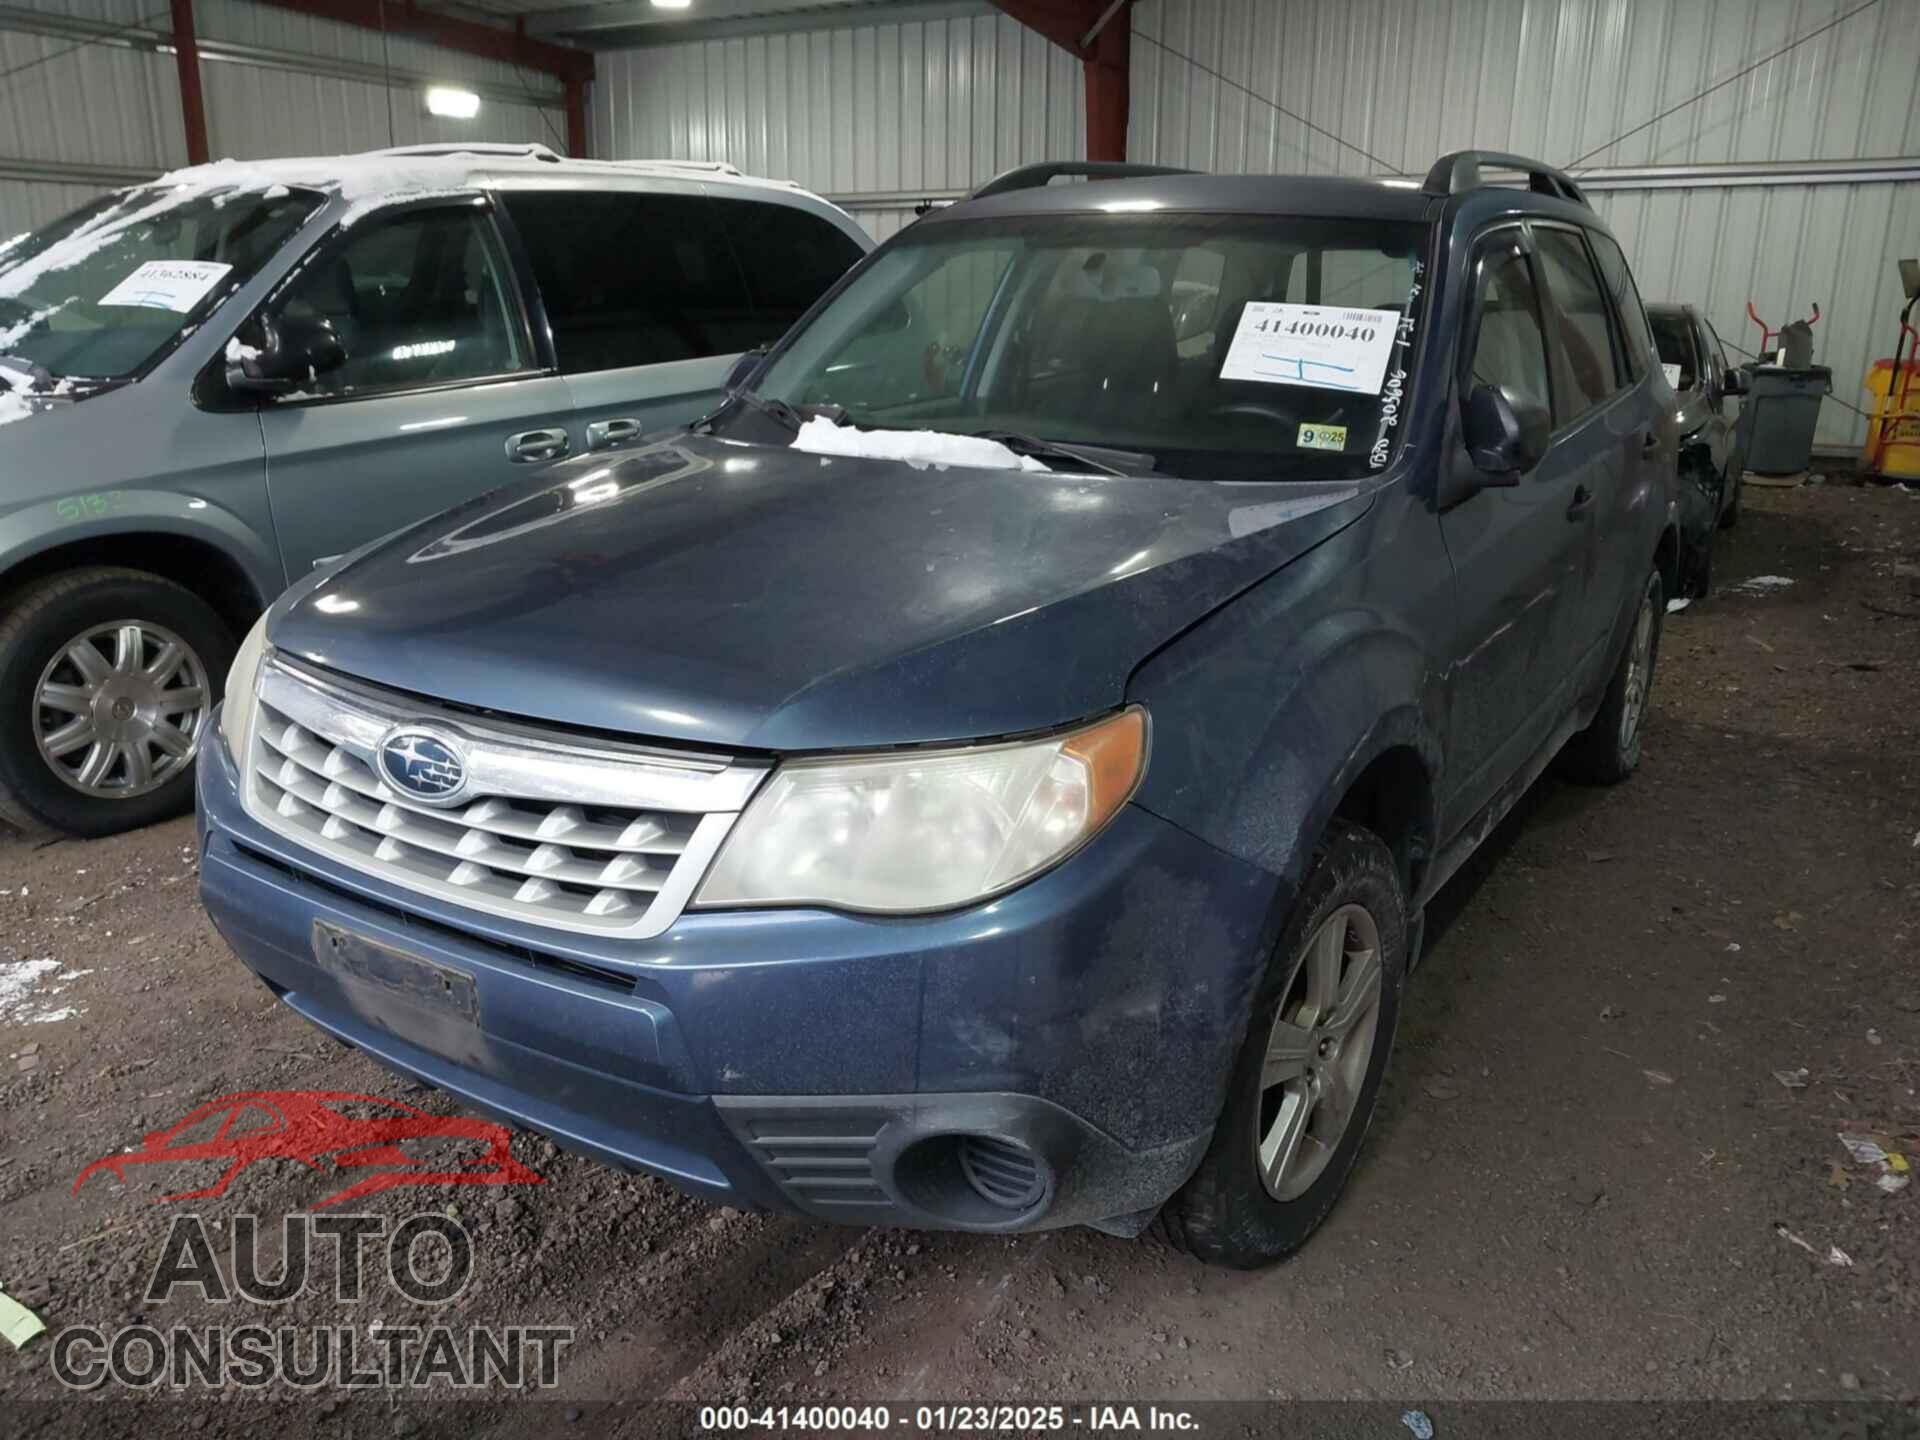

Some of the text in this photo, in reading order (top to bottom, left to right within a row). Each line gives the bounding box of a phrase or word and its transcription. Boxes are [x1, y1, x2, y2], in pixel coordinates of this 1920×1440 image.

[1254, 318, 1376, 343] 41400040
[1303, 430, 1345, 443] 9 25
